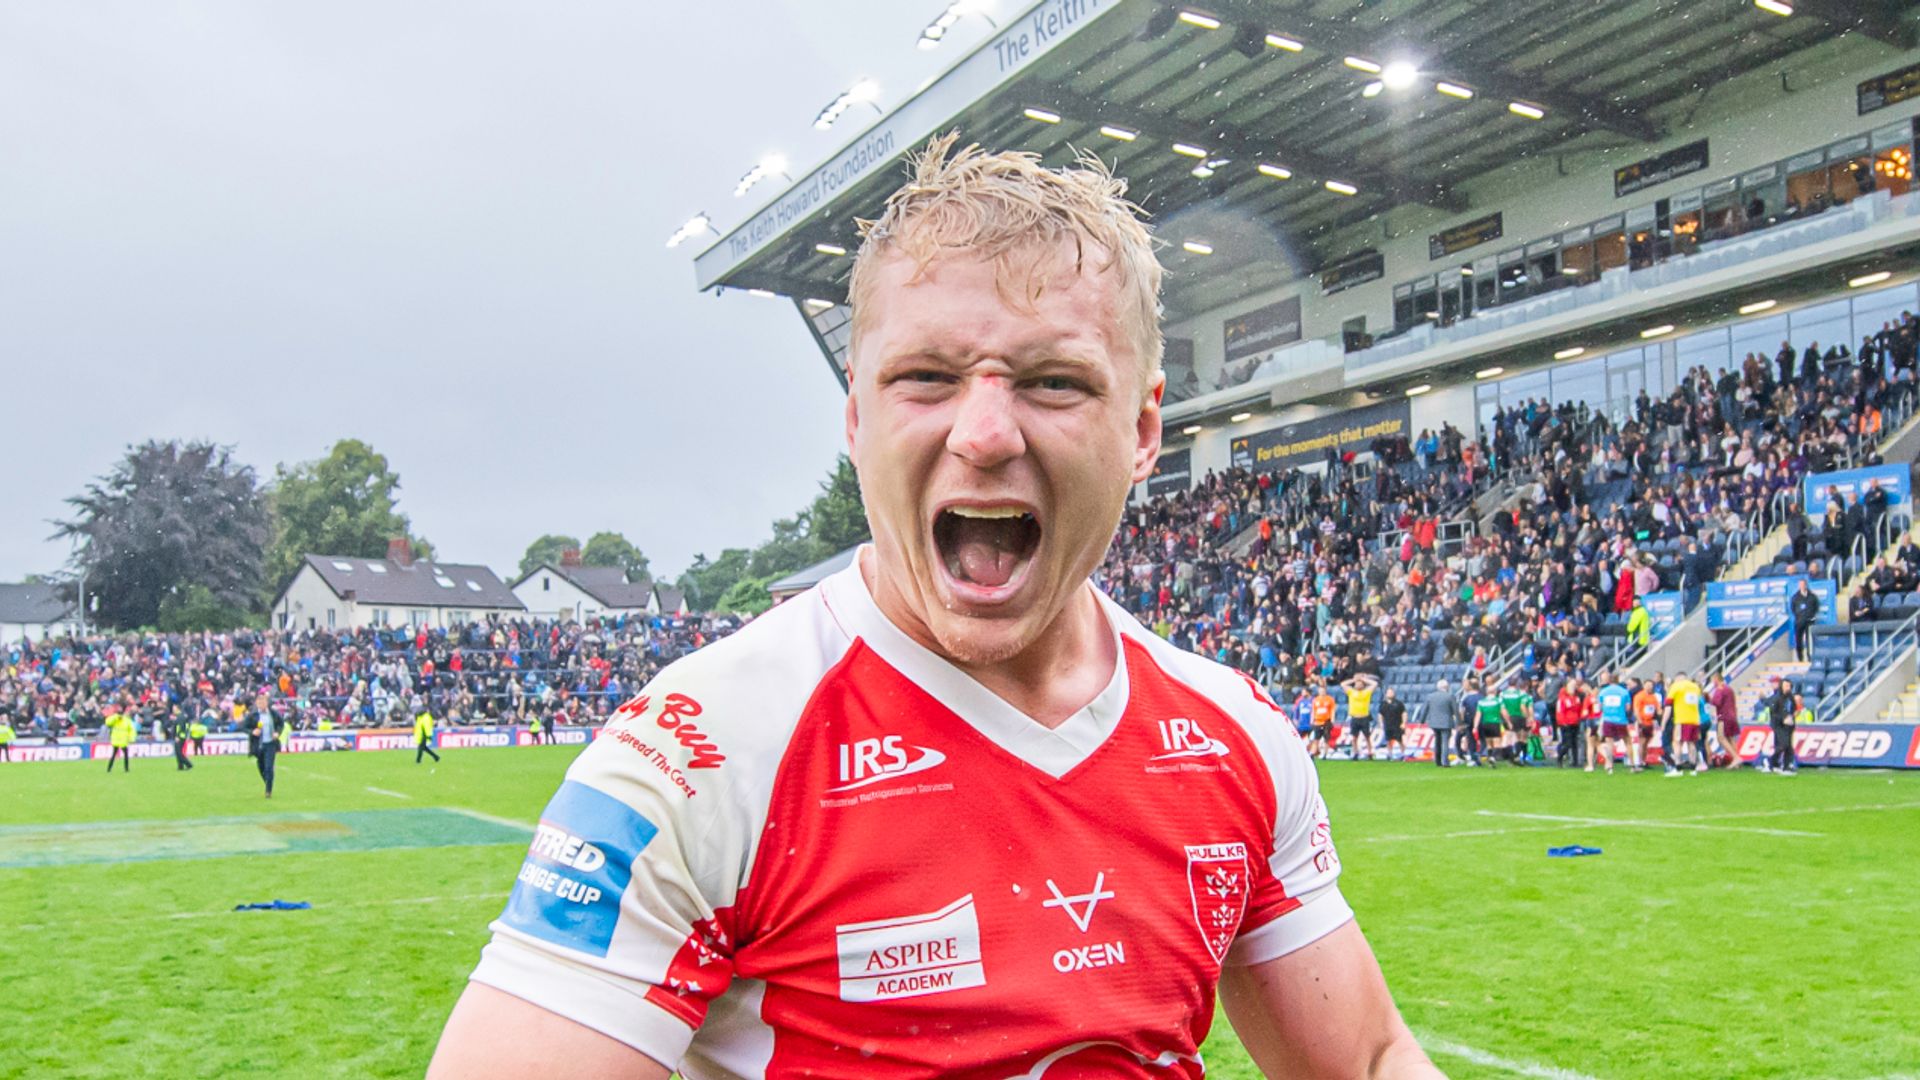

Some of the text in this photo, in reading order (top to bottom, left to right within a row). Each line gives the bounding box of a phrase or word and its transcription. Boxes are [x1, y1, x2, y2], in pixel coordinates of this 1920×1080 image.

[994, 33, 1030, 72] The
[728, 130, 895, 260] The Keith Howard Foundation
[1257, 447, 1272, 462] For
[1272, 443, 1290, 459] the
[1291, 432, 1339, 456] moments
[1340, 428, 1363, 444] that
[1364, 419, 1404, 438] matter
[442, 733, 510, 747] BETFRED
[656, 693, 726, 769] Buy
[95, 743, 174, 759] BEFRED
[651, 752, 671, 774] The
[840, 735, 907, 781] IRS
[530, 824, 606, 872] TFRED
[1188, 846, 1225, 859] HULL
[556, 877, 602, 905] CUP
[865, 936, 959, 972] ASPIRE
[1053, 941, 1126, 973] OXEN
[876, 971, 954, 996] ACADEMY
